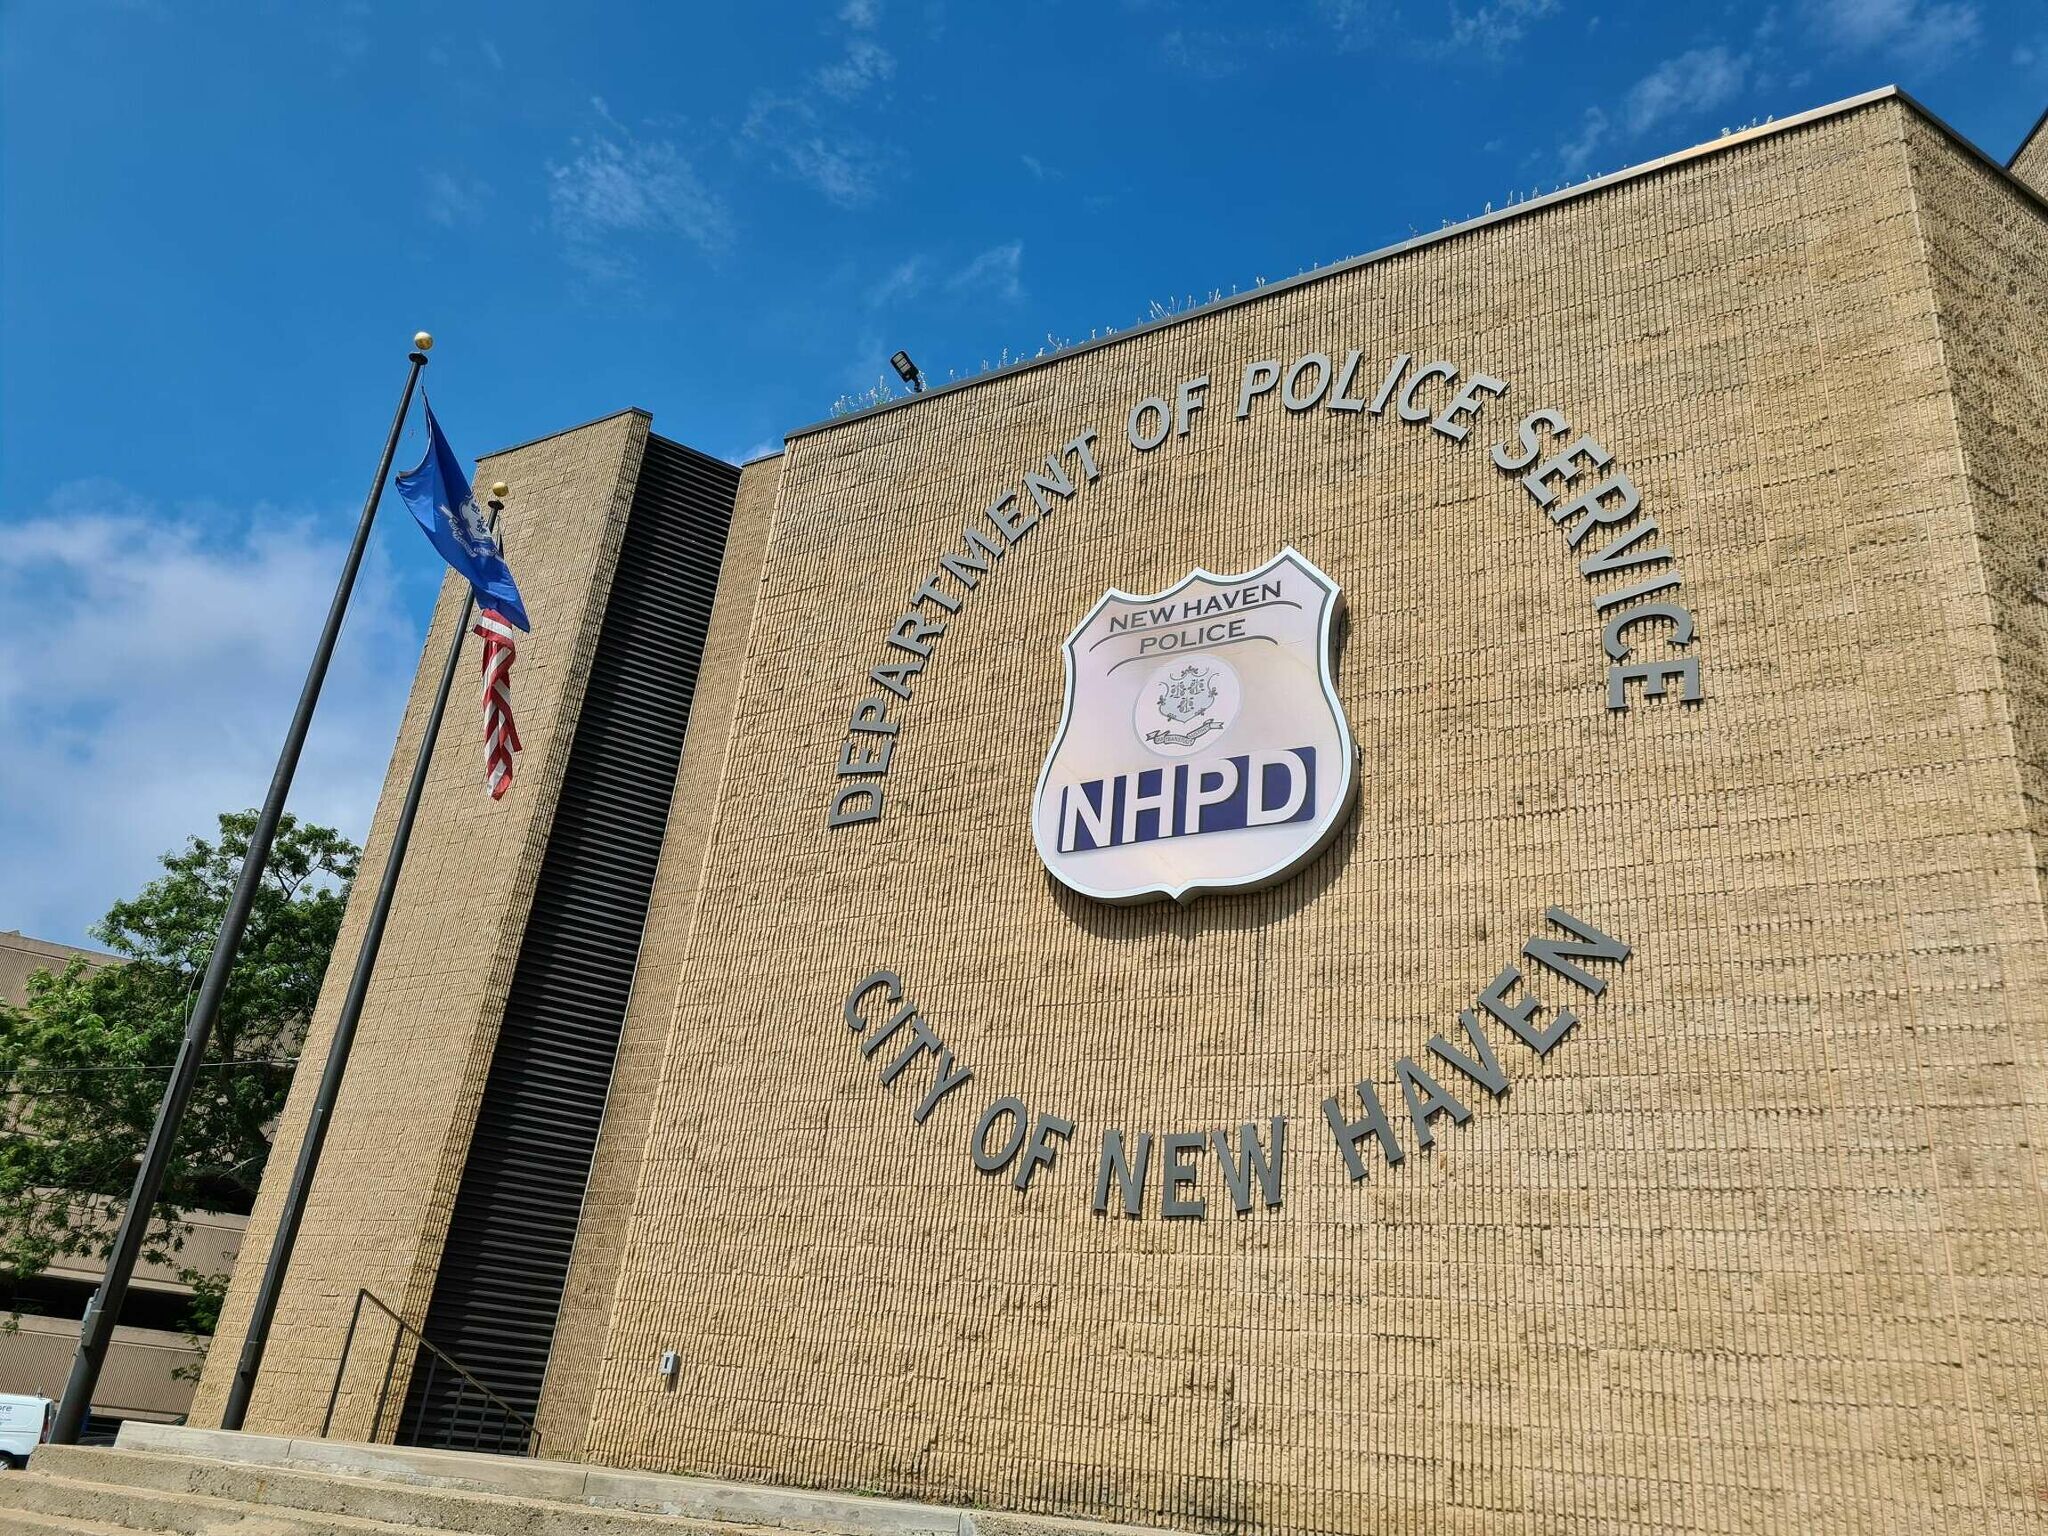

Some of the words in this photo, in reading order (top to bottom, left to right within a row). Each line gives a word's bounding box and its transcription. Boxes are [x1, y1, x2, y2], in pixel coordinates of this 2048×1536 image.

[829, 427, 1101, 827] DEPARTMENT
[1127, 375, 1209, 451] OF
[1236, 349, 1510, 441] POLICE
[1490, 408, 1703, 710] SERVICE
[1109, 604, 1176, 633] NEW
[1183, 580, 1282, 619] HAVEN
[1139, 618, 1246, 654] POLICE
[1061, 749, 1308, 852] NHPD
[844, 969, 973, 1124] CITY
[971, 1096, 1075, 1190] OF
[1092, 1115, 1287, 1217] NEW
[1322, 904, 1633, 1181] HAVEN
